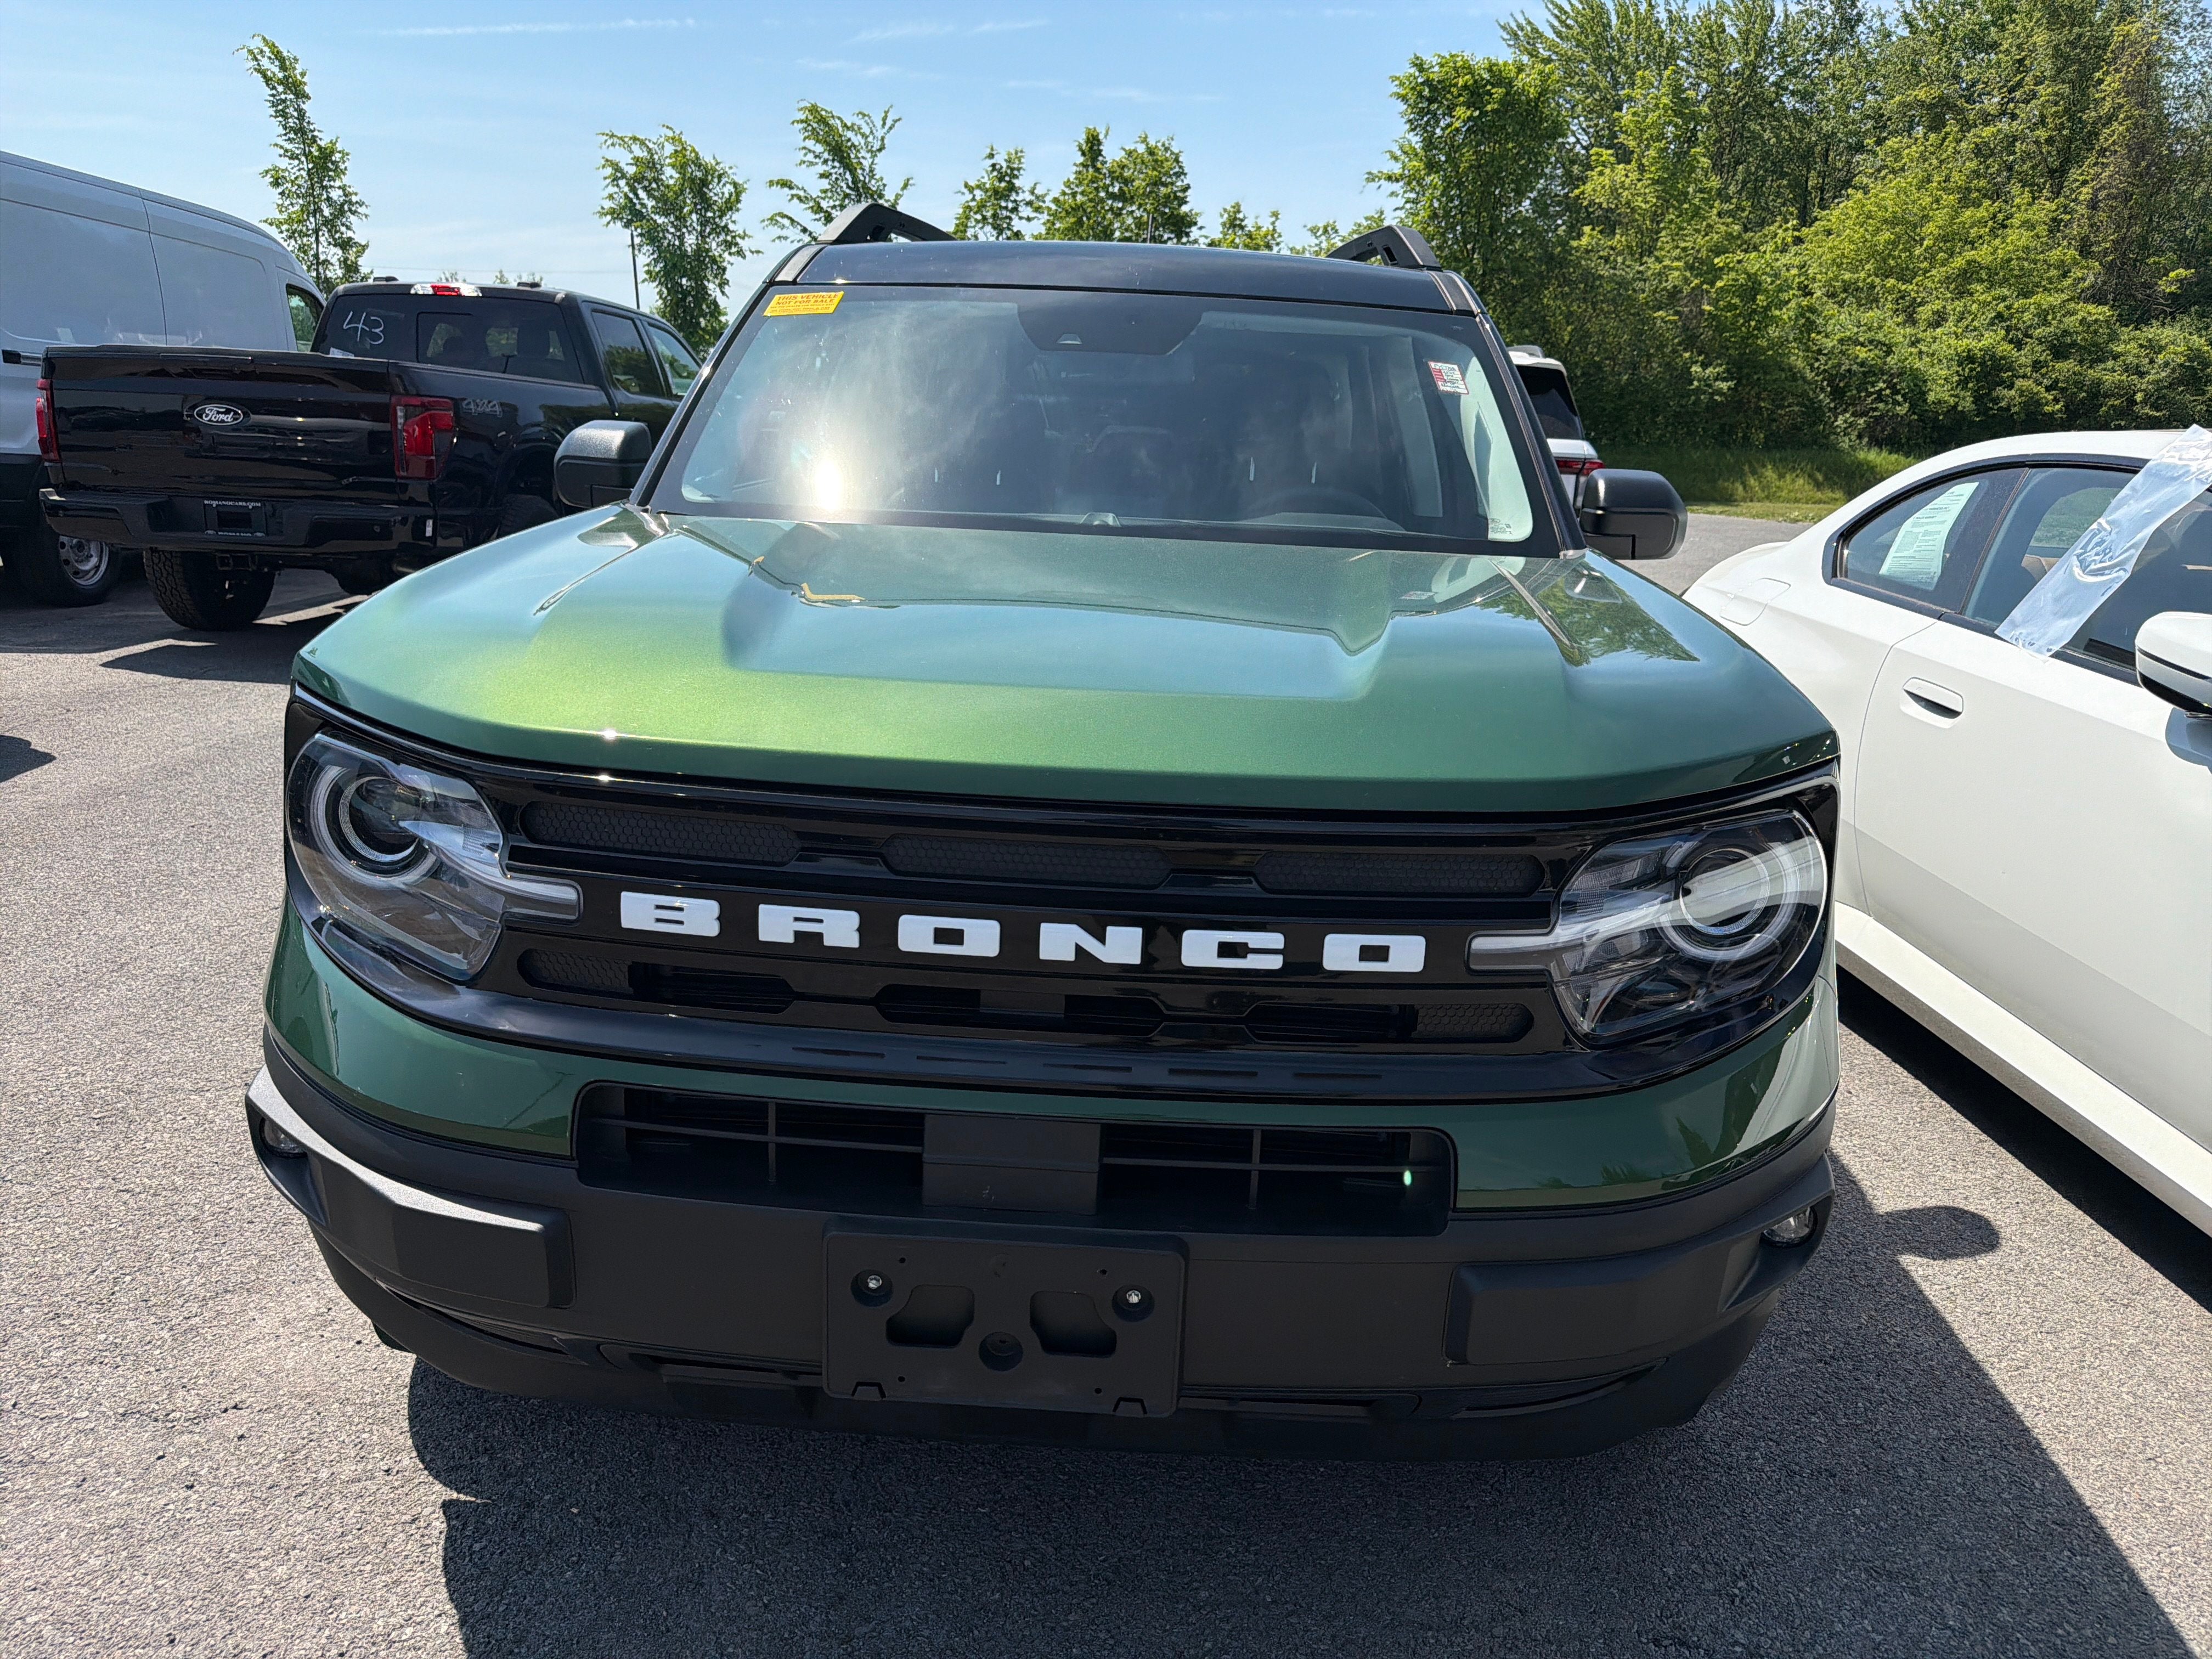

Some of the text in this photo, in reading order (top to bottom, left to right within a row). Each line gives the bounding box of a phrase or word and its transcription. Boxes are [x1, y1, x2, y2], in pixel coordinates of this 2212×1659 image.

[343, 311, 384, 345] 43
[202, 407, 234, 422] Ford
[620, 891, 1426, 973] BRONCO
